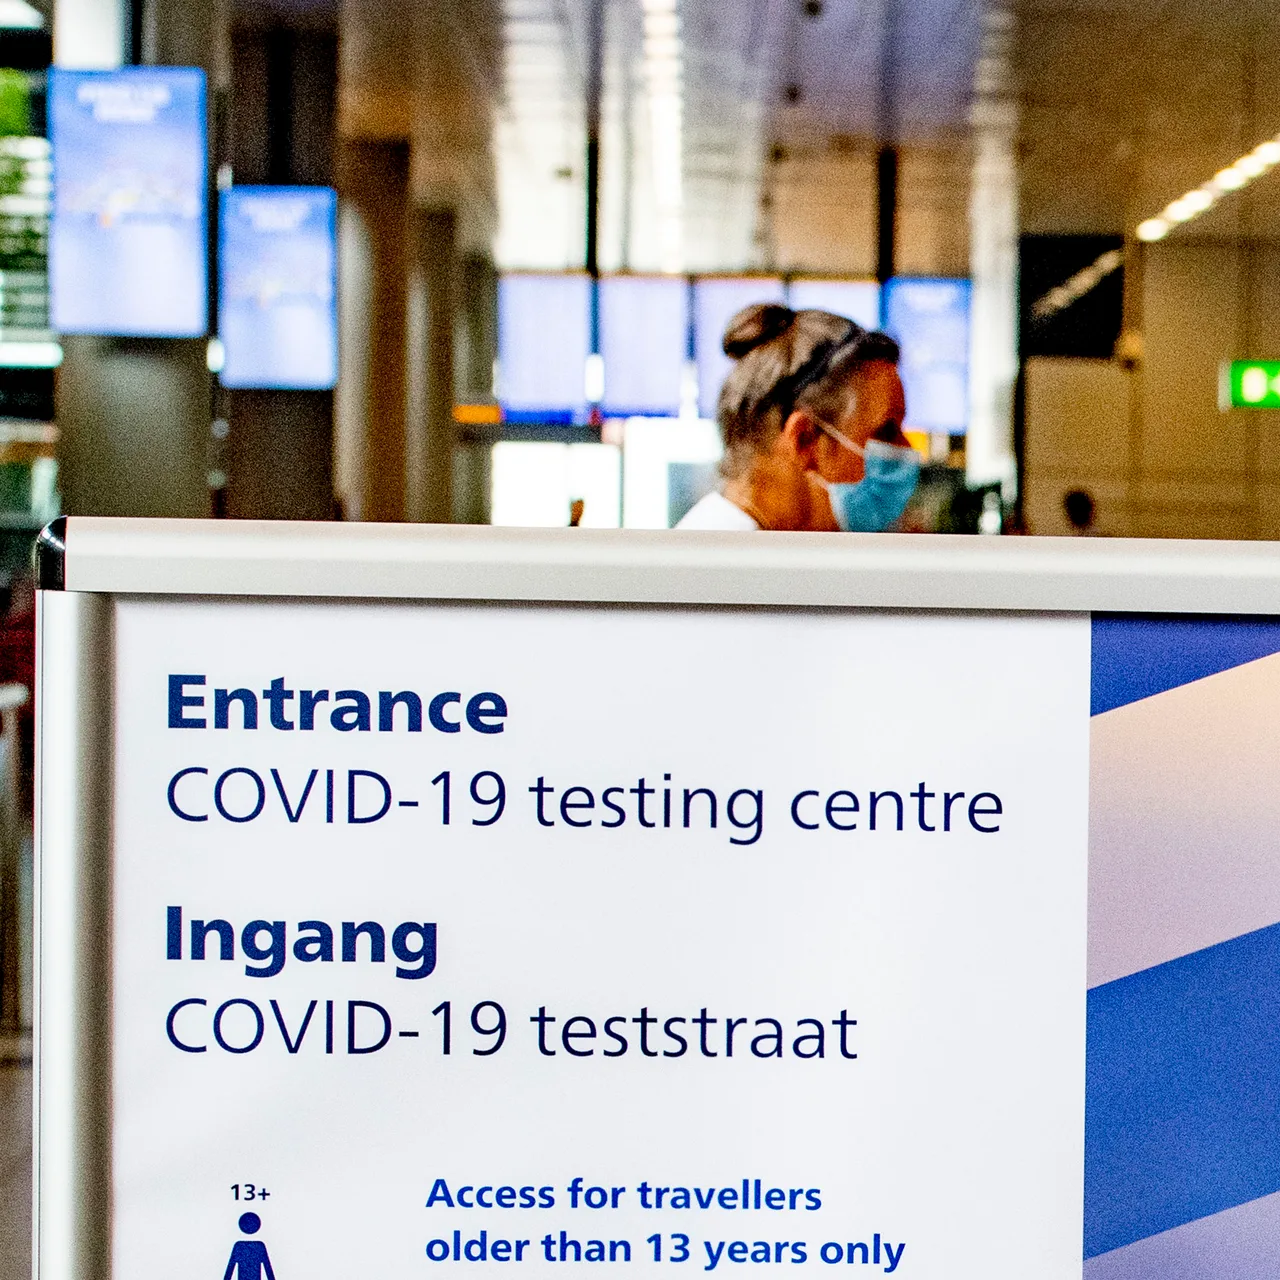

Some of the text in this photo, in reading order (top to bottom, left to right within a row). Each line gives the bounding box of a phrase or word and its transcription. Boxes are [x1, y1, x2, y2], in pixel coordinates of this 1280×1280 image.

[168, 675, 507, 734] Entrance
[168, 767, 1002, 845] COVID-19 testing centre
[167, 906, 436, 979] Ingang
[166, 998, 857, 1059] COVID-19 teststraat
[231, 1184, 270, 1200] 13+
[426, 1178, 821, 1210] Access for travellers
[426, 1230, 905, 1273] older than 13 years only
